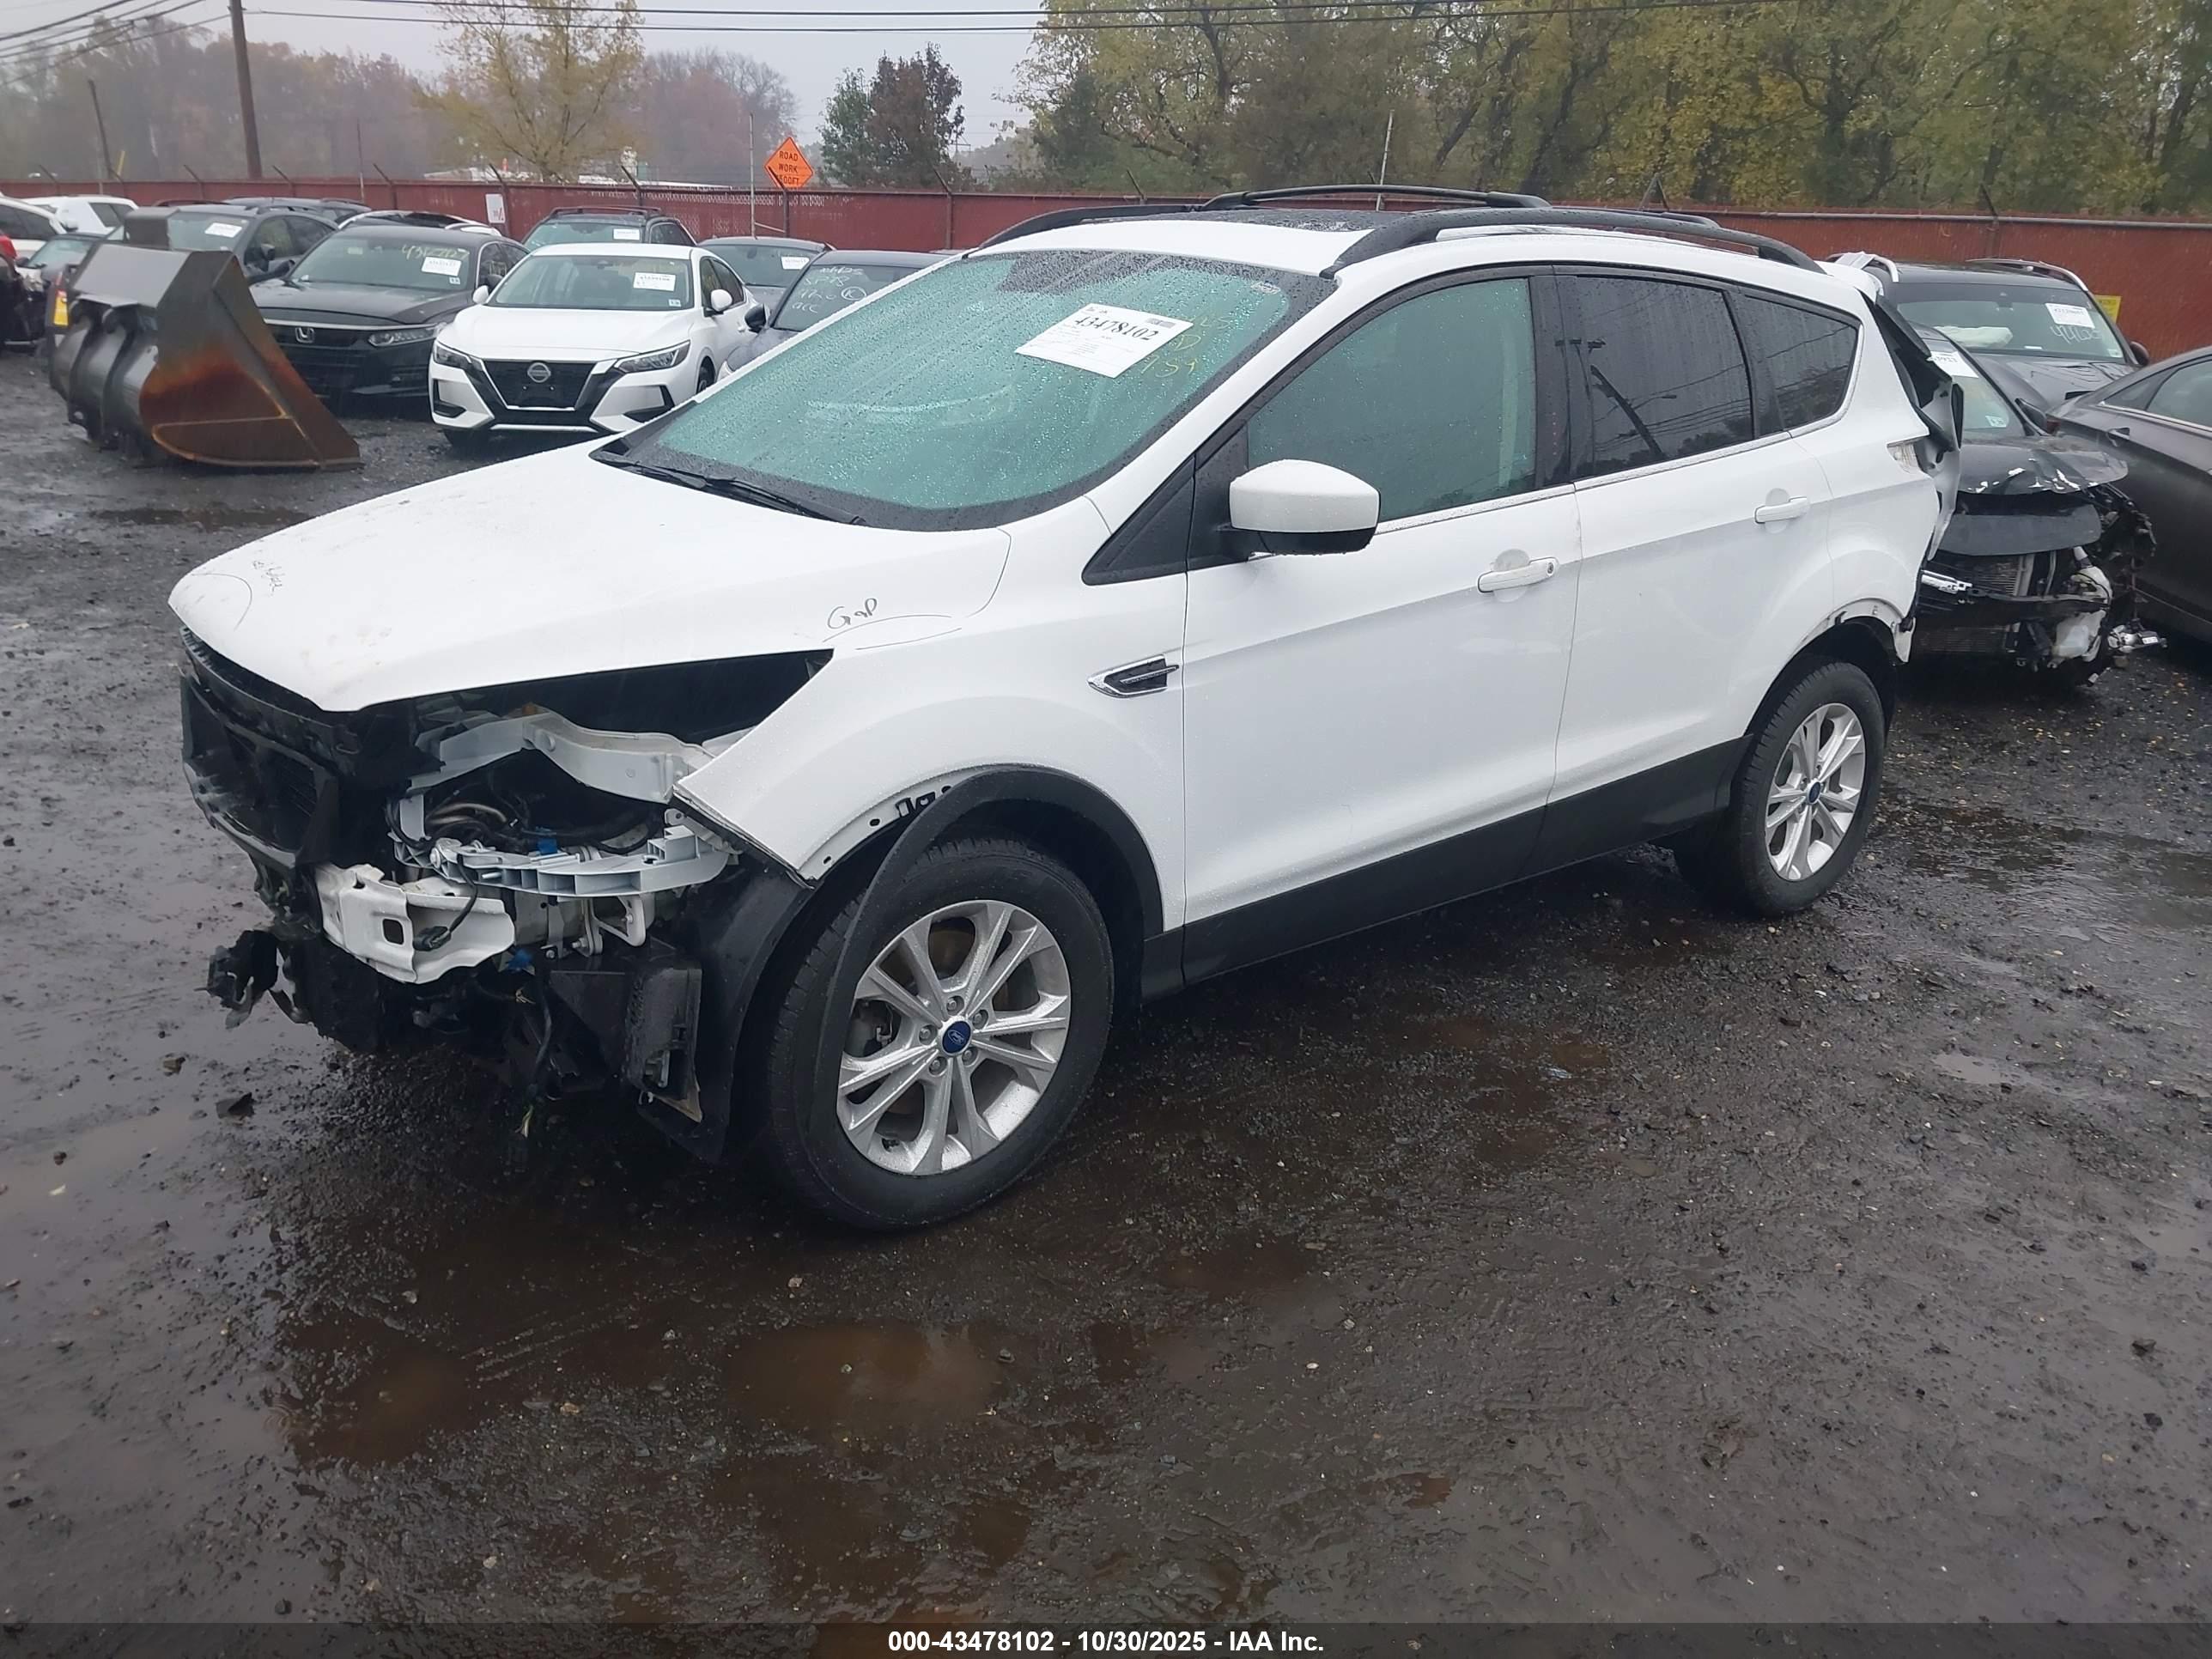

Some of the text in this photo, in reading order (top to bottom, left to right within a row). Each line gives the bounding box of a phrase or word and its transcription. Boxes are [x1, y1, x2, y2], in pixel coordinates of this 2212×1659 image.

[780, 151, 799, 161] ROAD
[778, 163, 799, 173] WORK
[1075, 316, 1159, 342] 43478102
